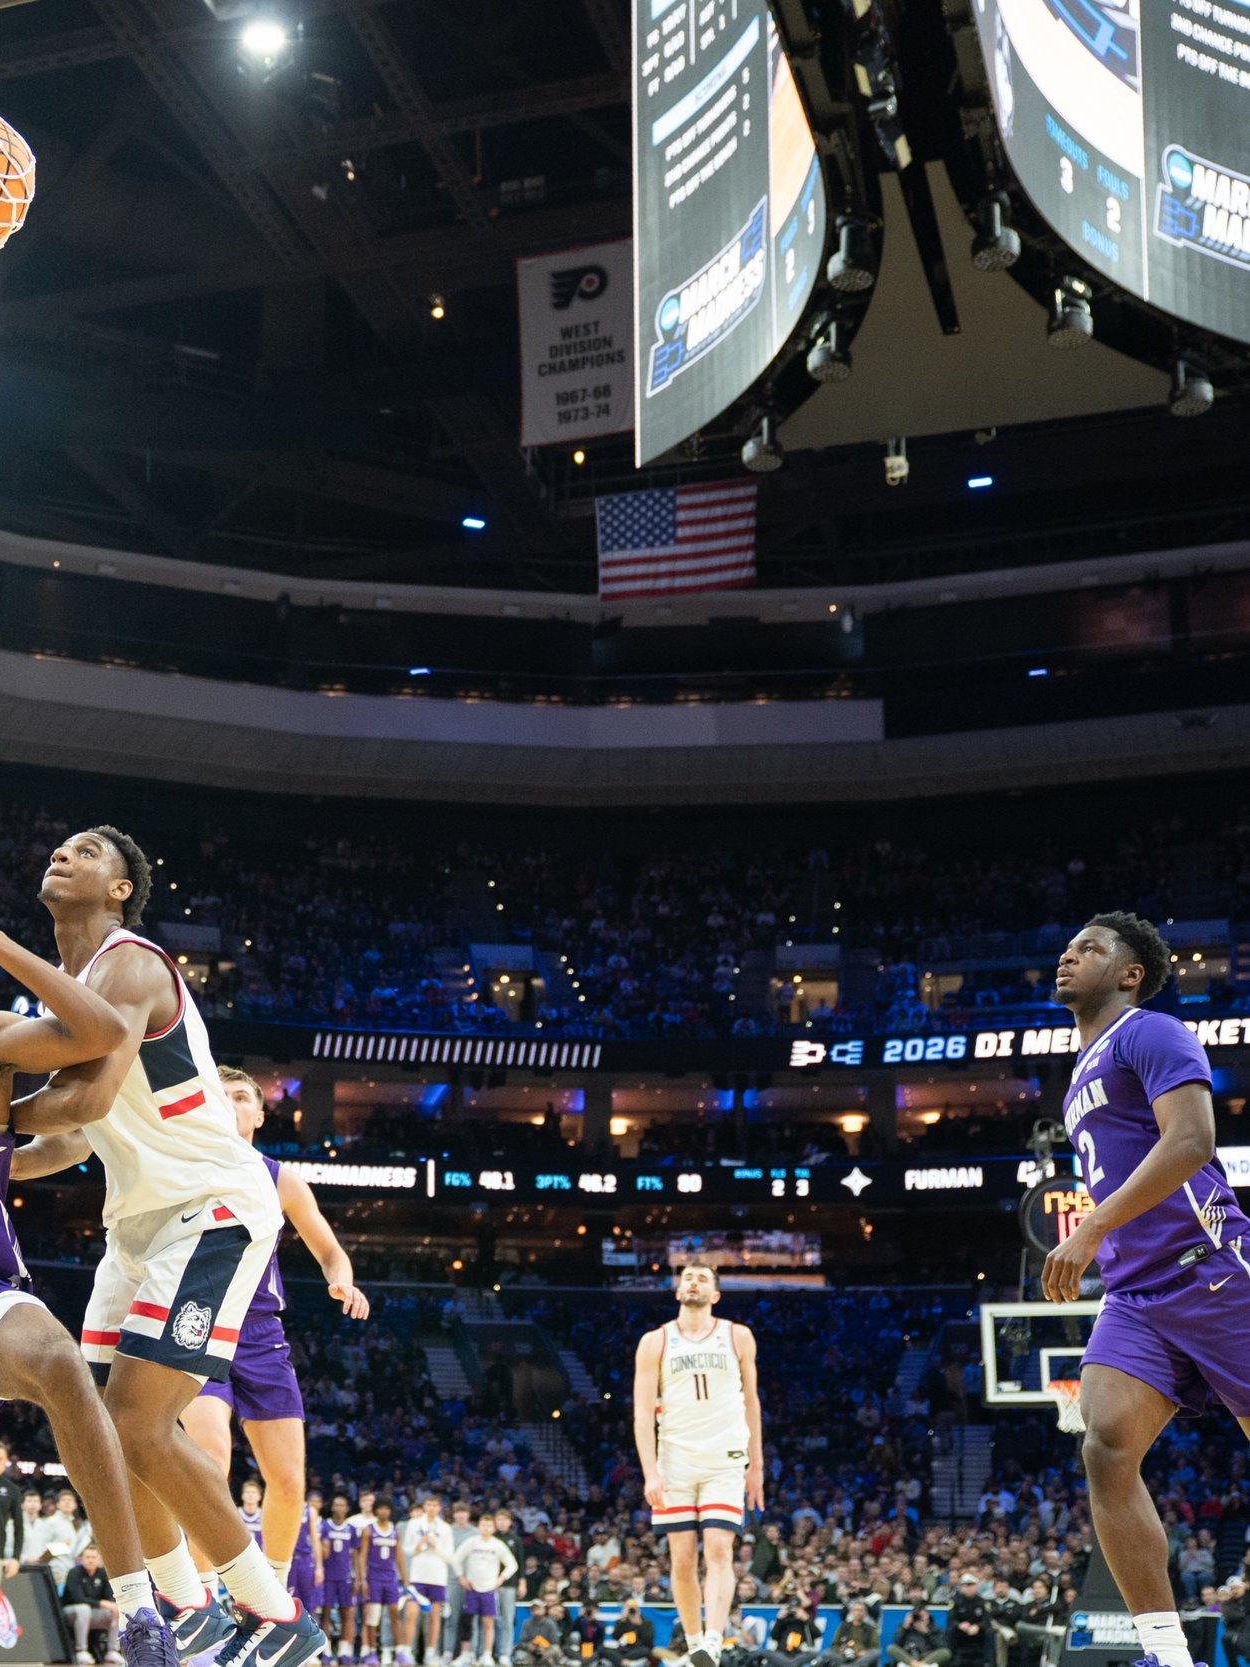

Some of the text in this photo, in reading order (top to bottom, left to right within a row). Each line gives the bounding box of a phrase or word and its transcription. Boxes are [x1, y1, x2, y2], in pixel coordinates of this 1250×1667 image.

[1060, 156, 1074, 194] 3
[1106, 196, 1121, 233] 2
[560, 320, 600, 341] WEST
[549, 334, 613, 360] DIVISION
[537, 350, 626, 379] CHAMPIONS
[883, 1035, 967, 1063] 2026
[1078, 1129, 1105, 1189] 2
[444, 1171, 472, 1187] FG%
[535, 1174, 571, 1190] 3PT%
[636, 1175, 663, 1191] FT%
[771, 1179, 785, 1197] 2
[904, 1166, 983, 1191] FURMAN
[670, 1352, 728, 1375] CONNECTICUT
[693, 1373, 709, 1401] 11
